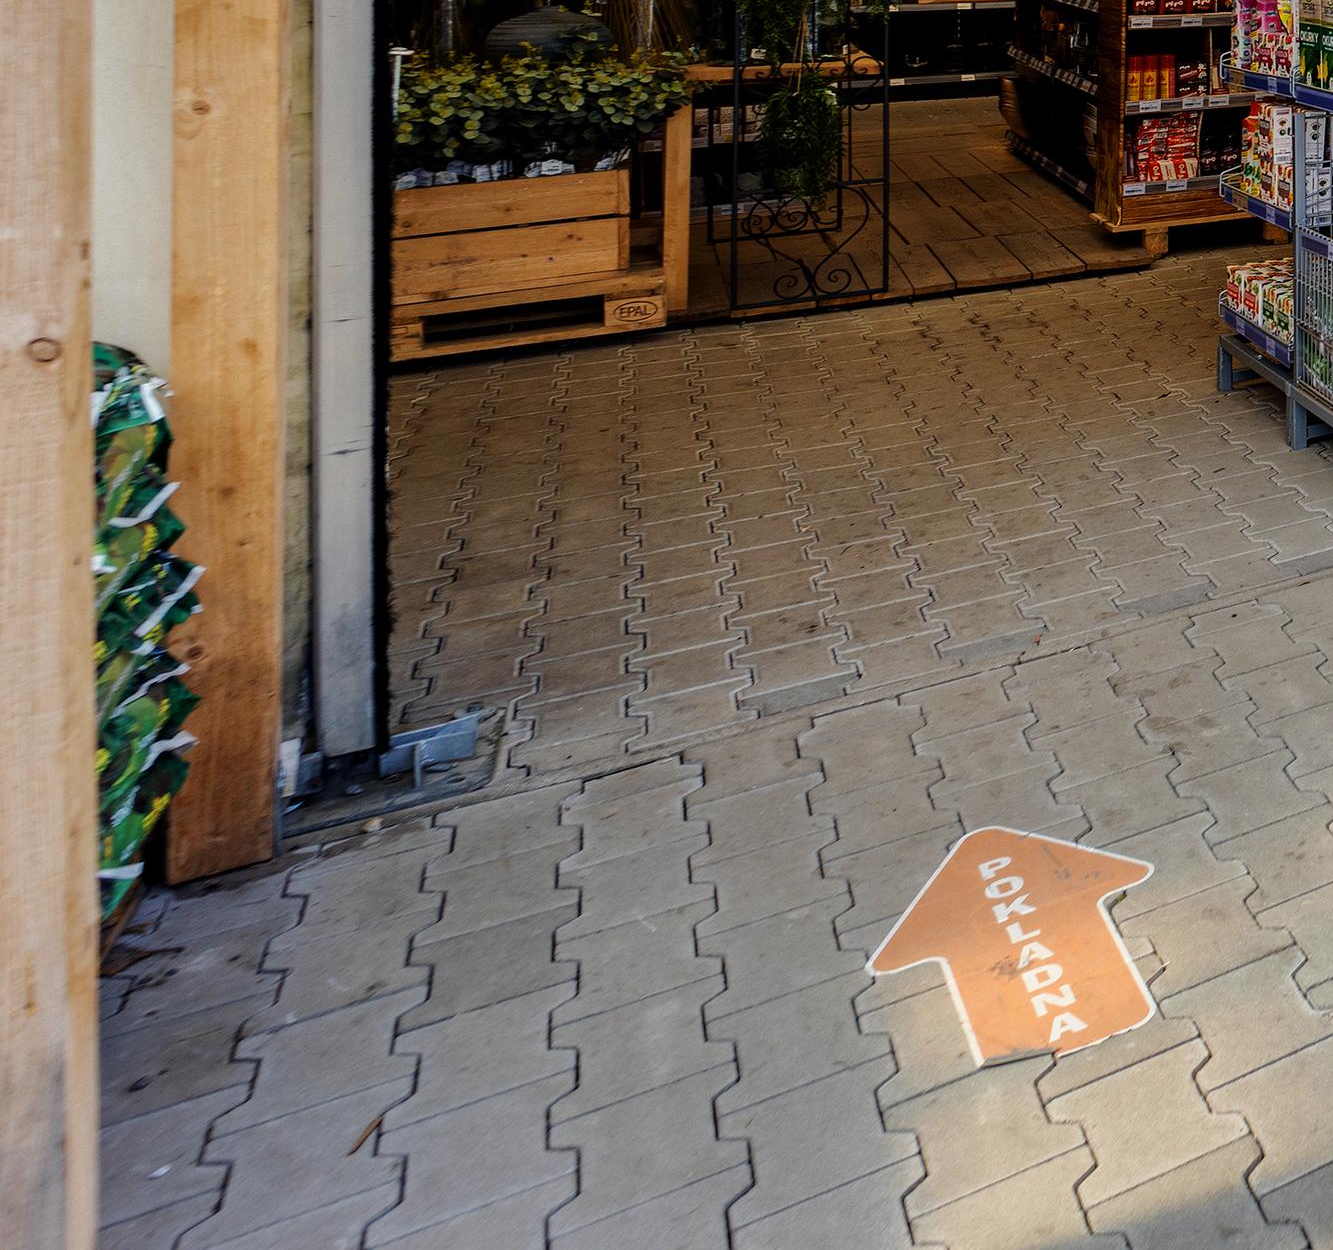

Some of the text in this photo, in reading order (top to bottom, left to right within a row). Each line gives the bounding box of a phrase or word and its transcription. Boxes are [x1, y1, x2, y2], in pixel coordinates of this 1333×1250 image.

[1165, 0, 1183, 8] PEPO
[618, 302, 652, 321] EPAL
[978, 856, 1088, 1043] POKLADNA
